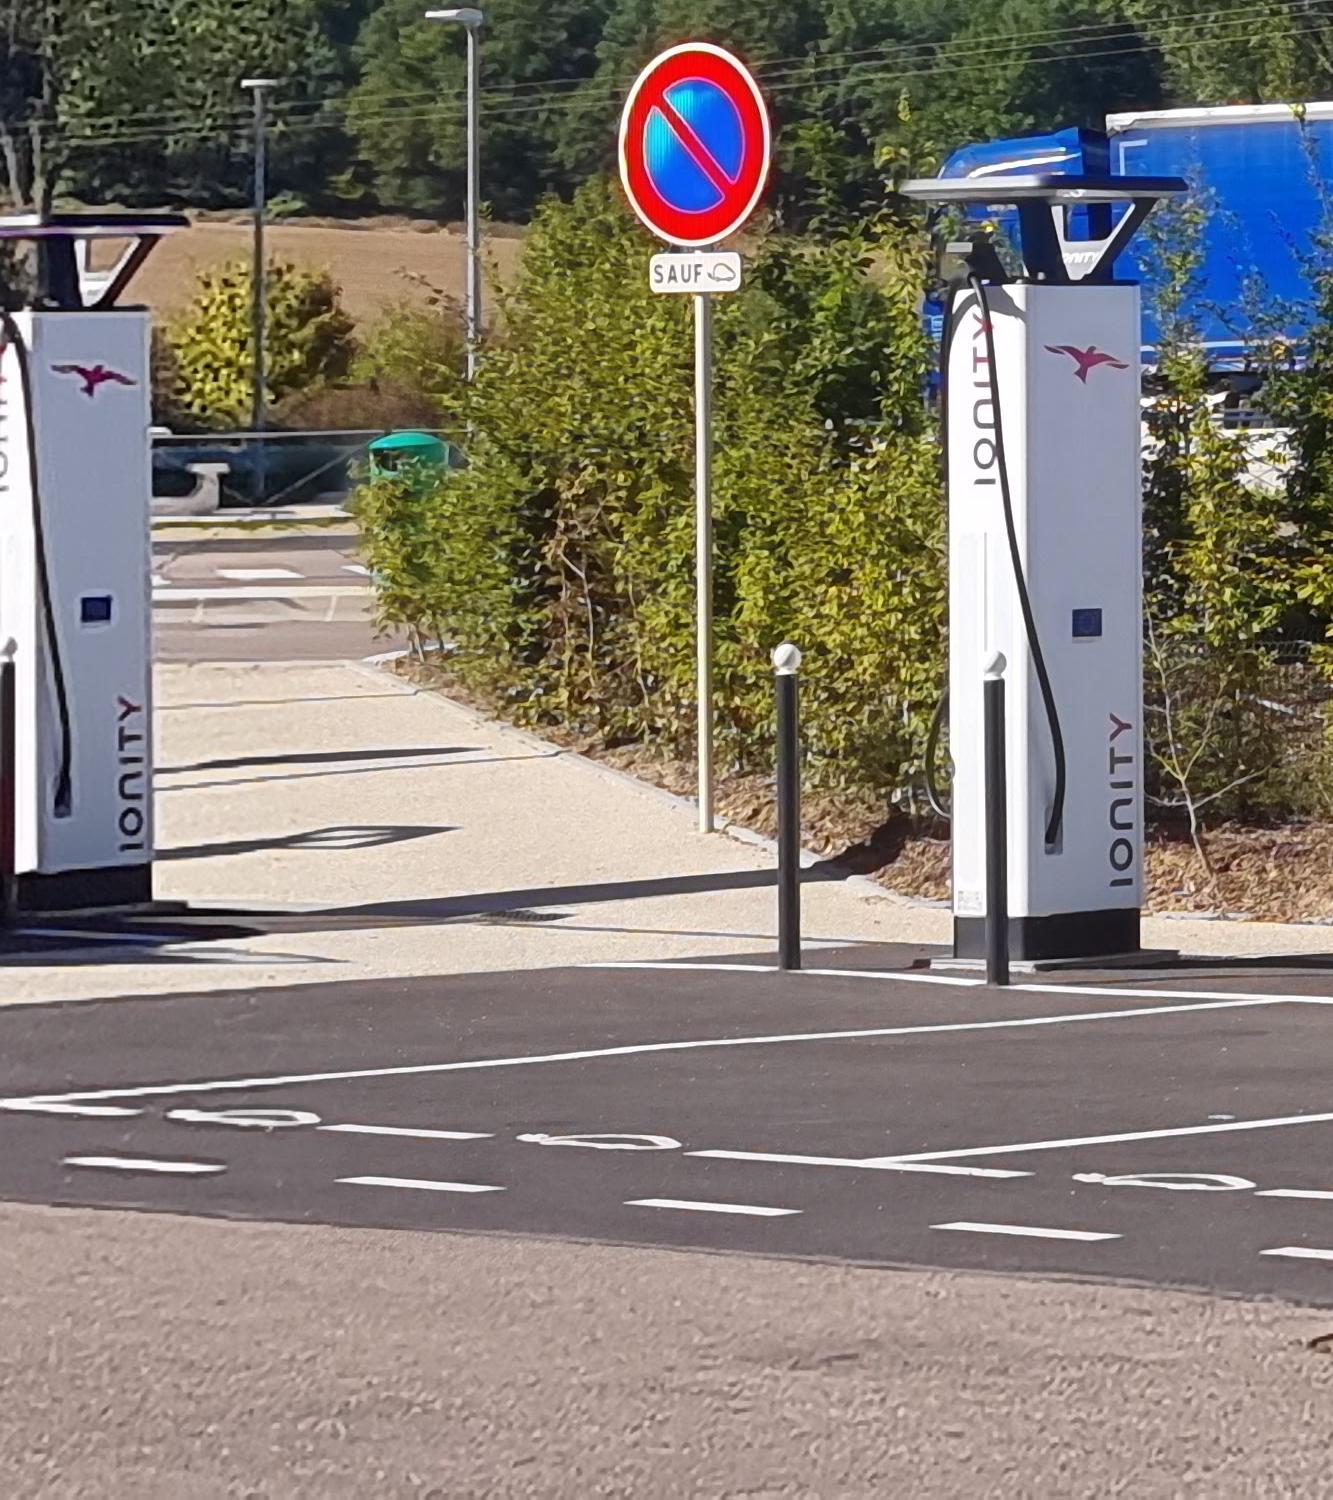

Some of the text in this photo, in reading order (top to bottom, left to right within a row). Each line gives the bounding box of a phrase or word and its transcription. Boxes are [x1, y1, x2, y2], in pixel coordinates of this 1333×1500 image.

[653, 264, 703, 284] SAUF
[972, 312, 996, 486] IONITY
[117, 695, 144, 852] IONITY
[1109, 712, 1134, 887] IONITY
